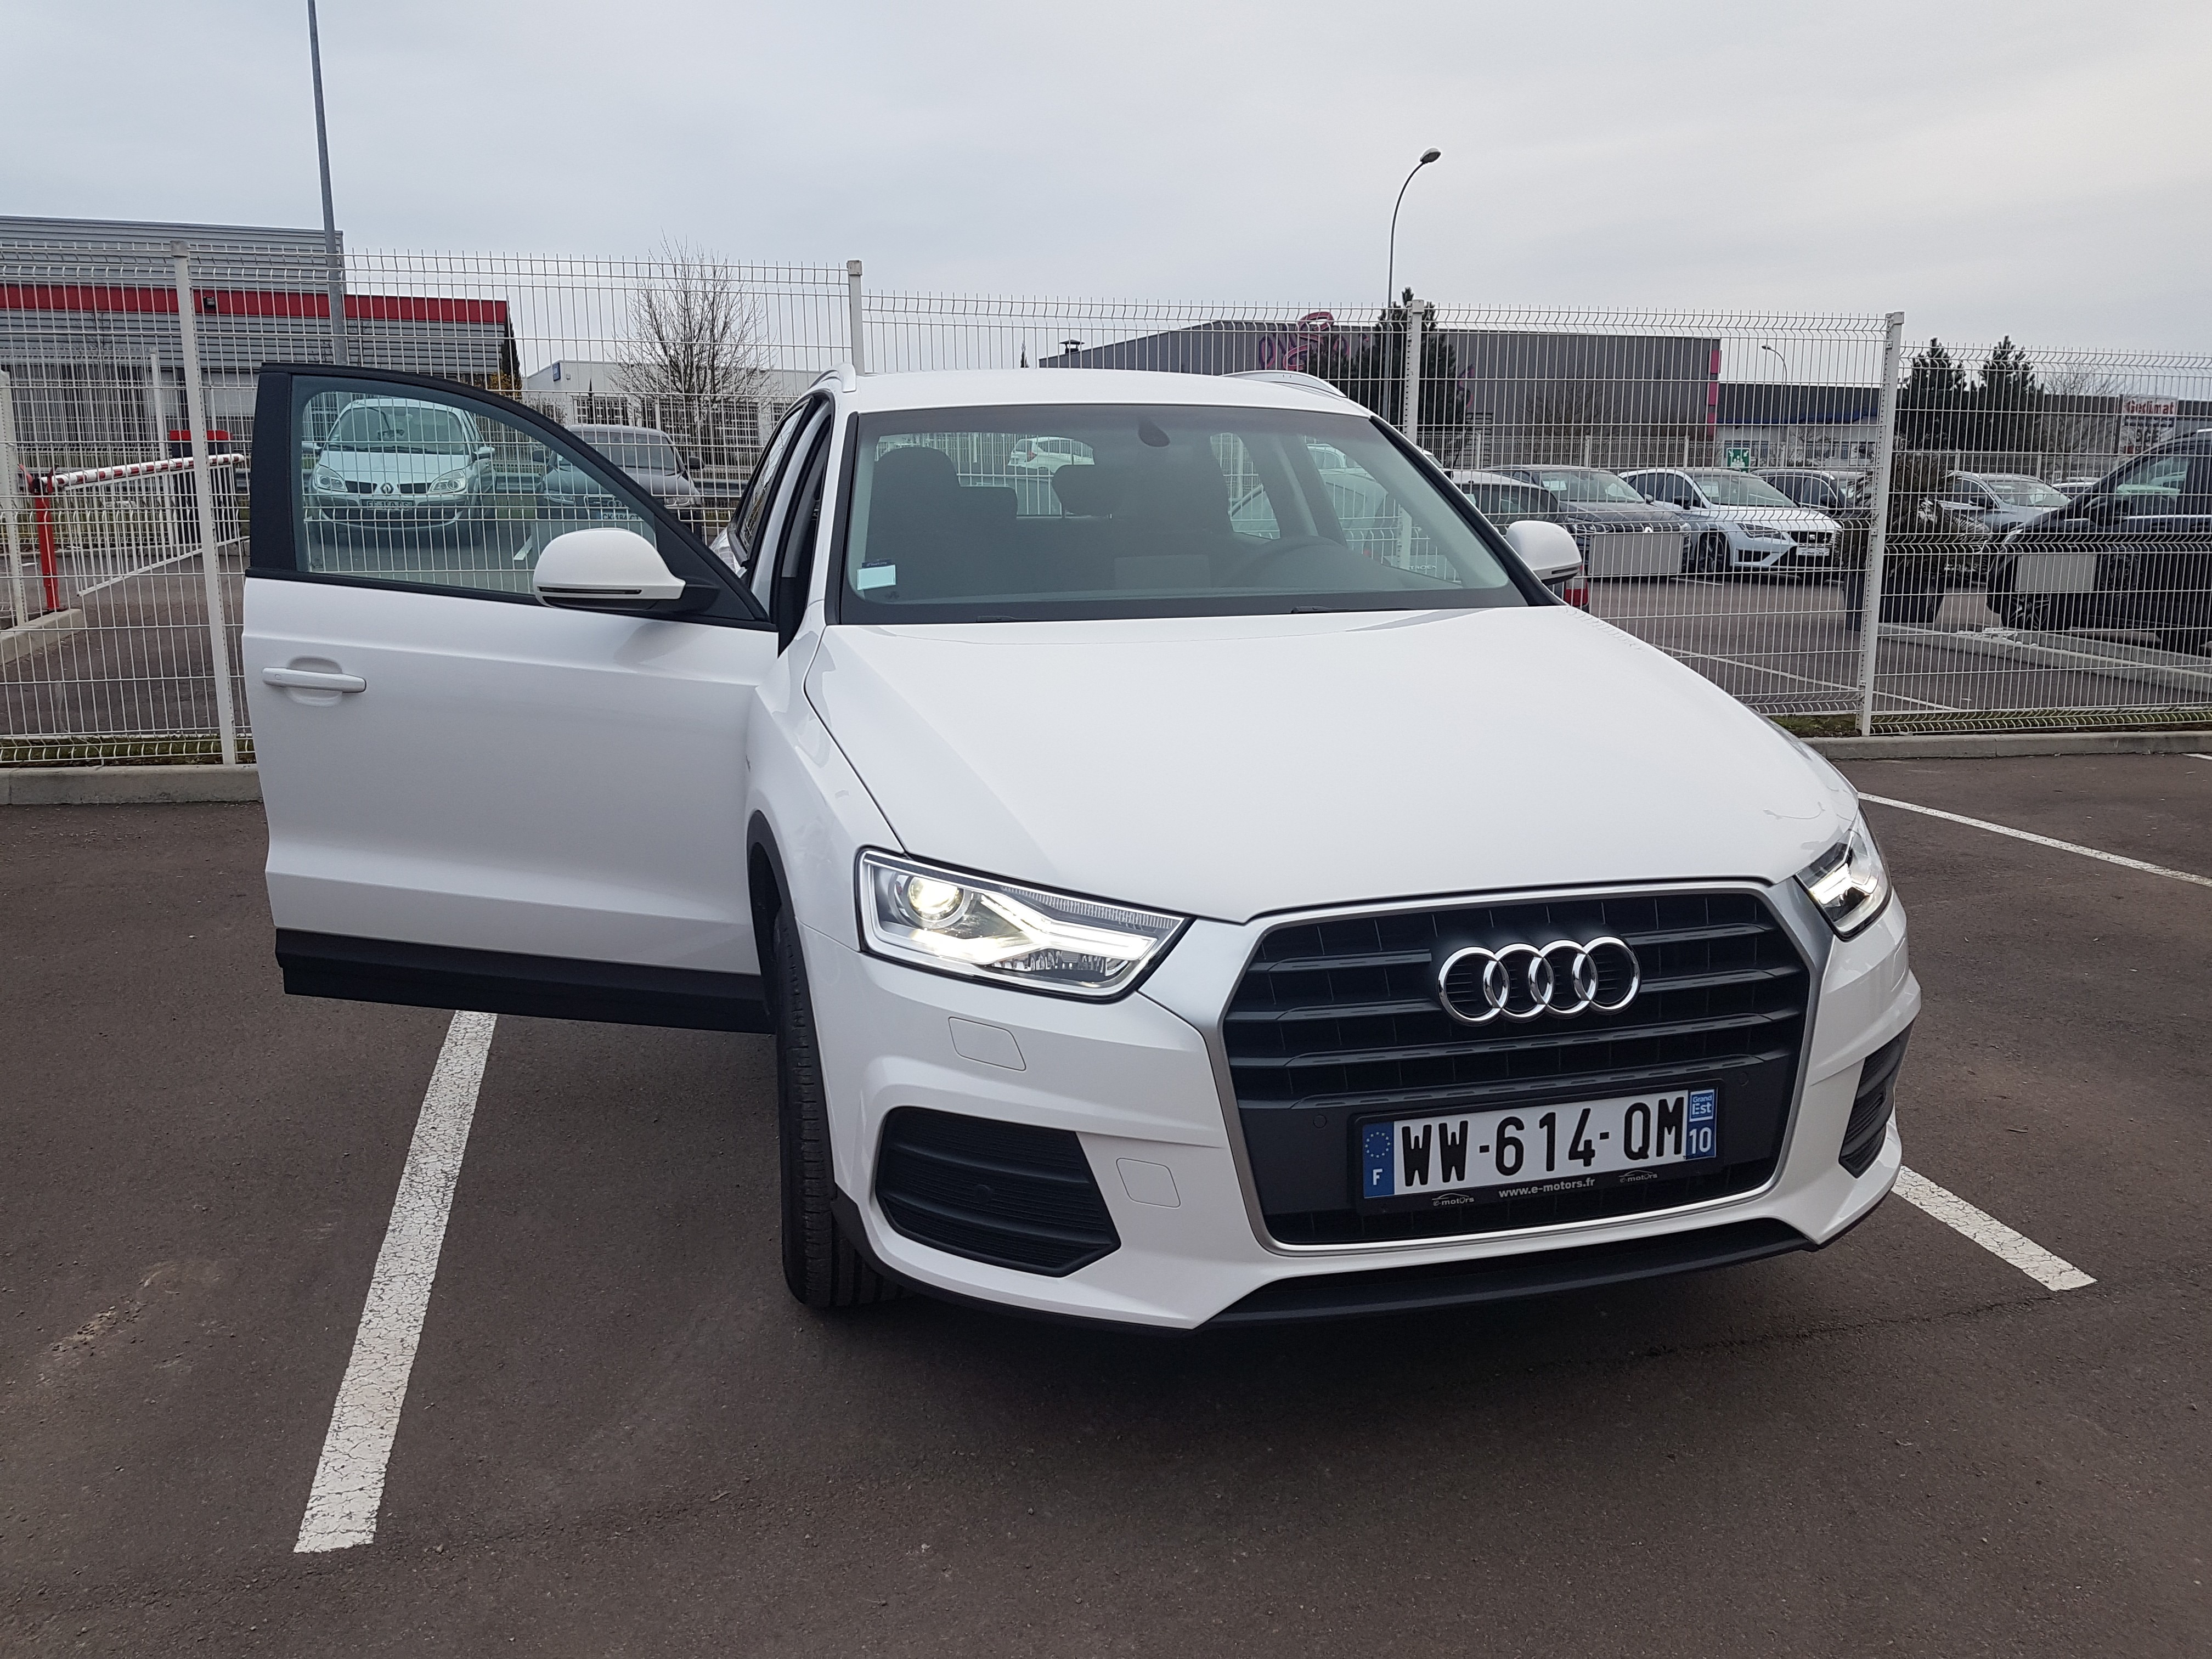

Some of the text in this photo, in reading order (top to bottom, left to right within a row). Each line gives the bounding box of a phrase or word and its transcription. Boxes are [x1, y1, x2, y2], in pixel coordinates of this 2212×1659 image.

[1692, 1094, 1712, 1103] Grand
[1692, 1102, 1712, 1115] Est
[1401, 1097, 1685, 1187] WW-614-QM
[1690, 1127, 1712, 1154] 10
[1373, 1169, 1383, 1186] F
[1498, 1177, 1596, 1198] www.e-motors.fr
